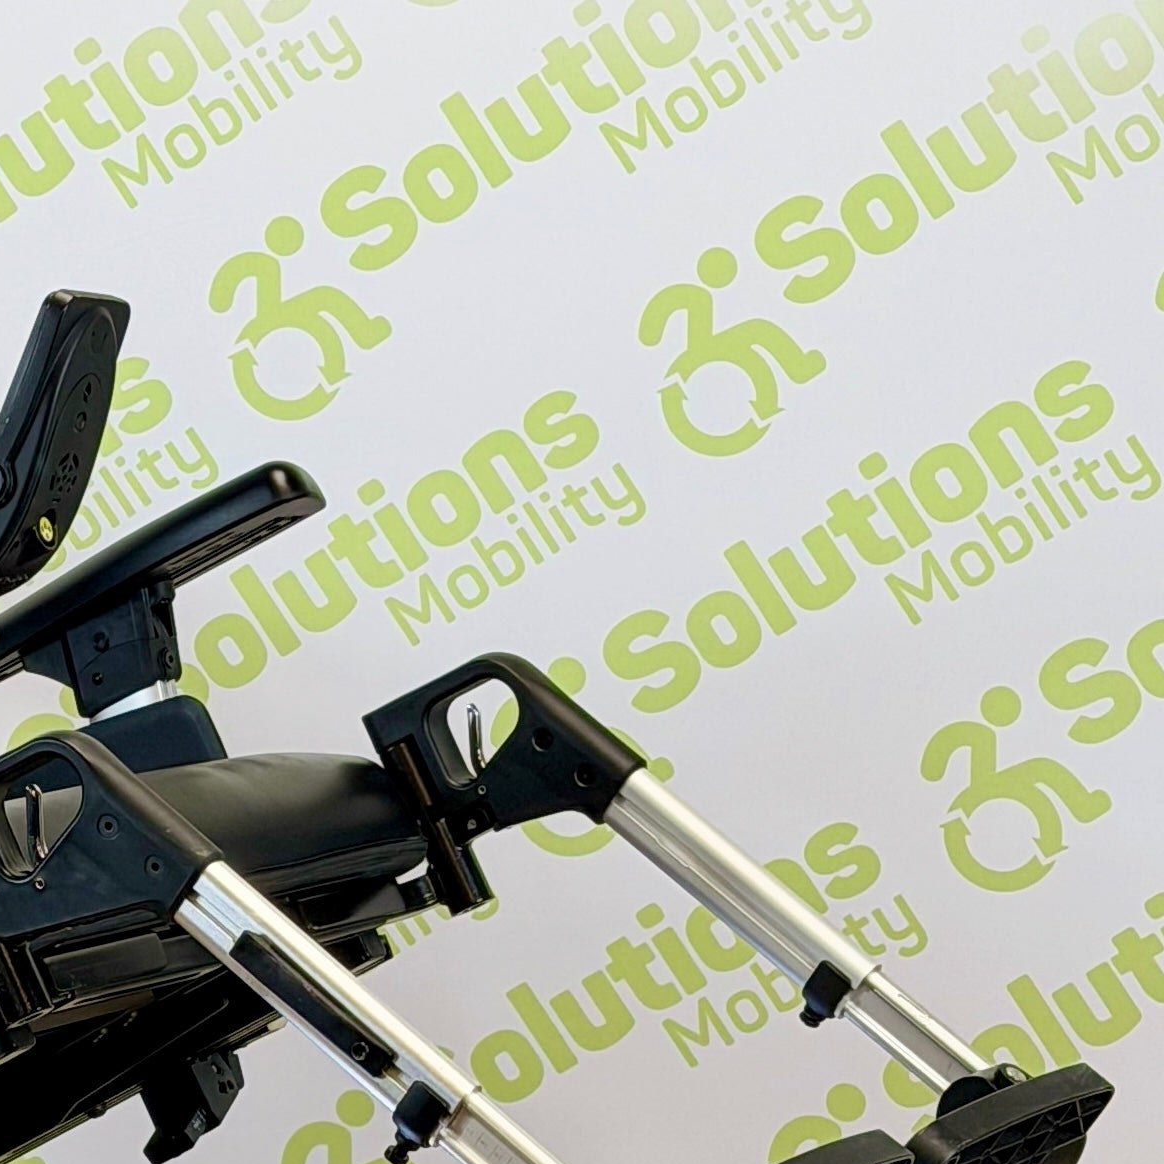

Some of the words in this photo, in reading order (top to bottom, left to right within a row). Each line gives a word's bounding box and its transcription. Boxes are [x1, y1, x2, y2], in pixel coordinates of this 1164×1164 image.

[102, 19, 361, 209] Mobility
[319, 0, 762, 272] Solutio
[599, 0, 872, 173] Mobility
[753, 0, 1164, 305] Solutio
[41, 424, 220, 574] bility
[384, 464, 646, 646] Mobility
[602, 360, 1114, 714] Solutions
[884, 436, 1161, 625] Mobility
[661, 896, 928, 1069] Mobty
